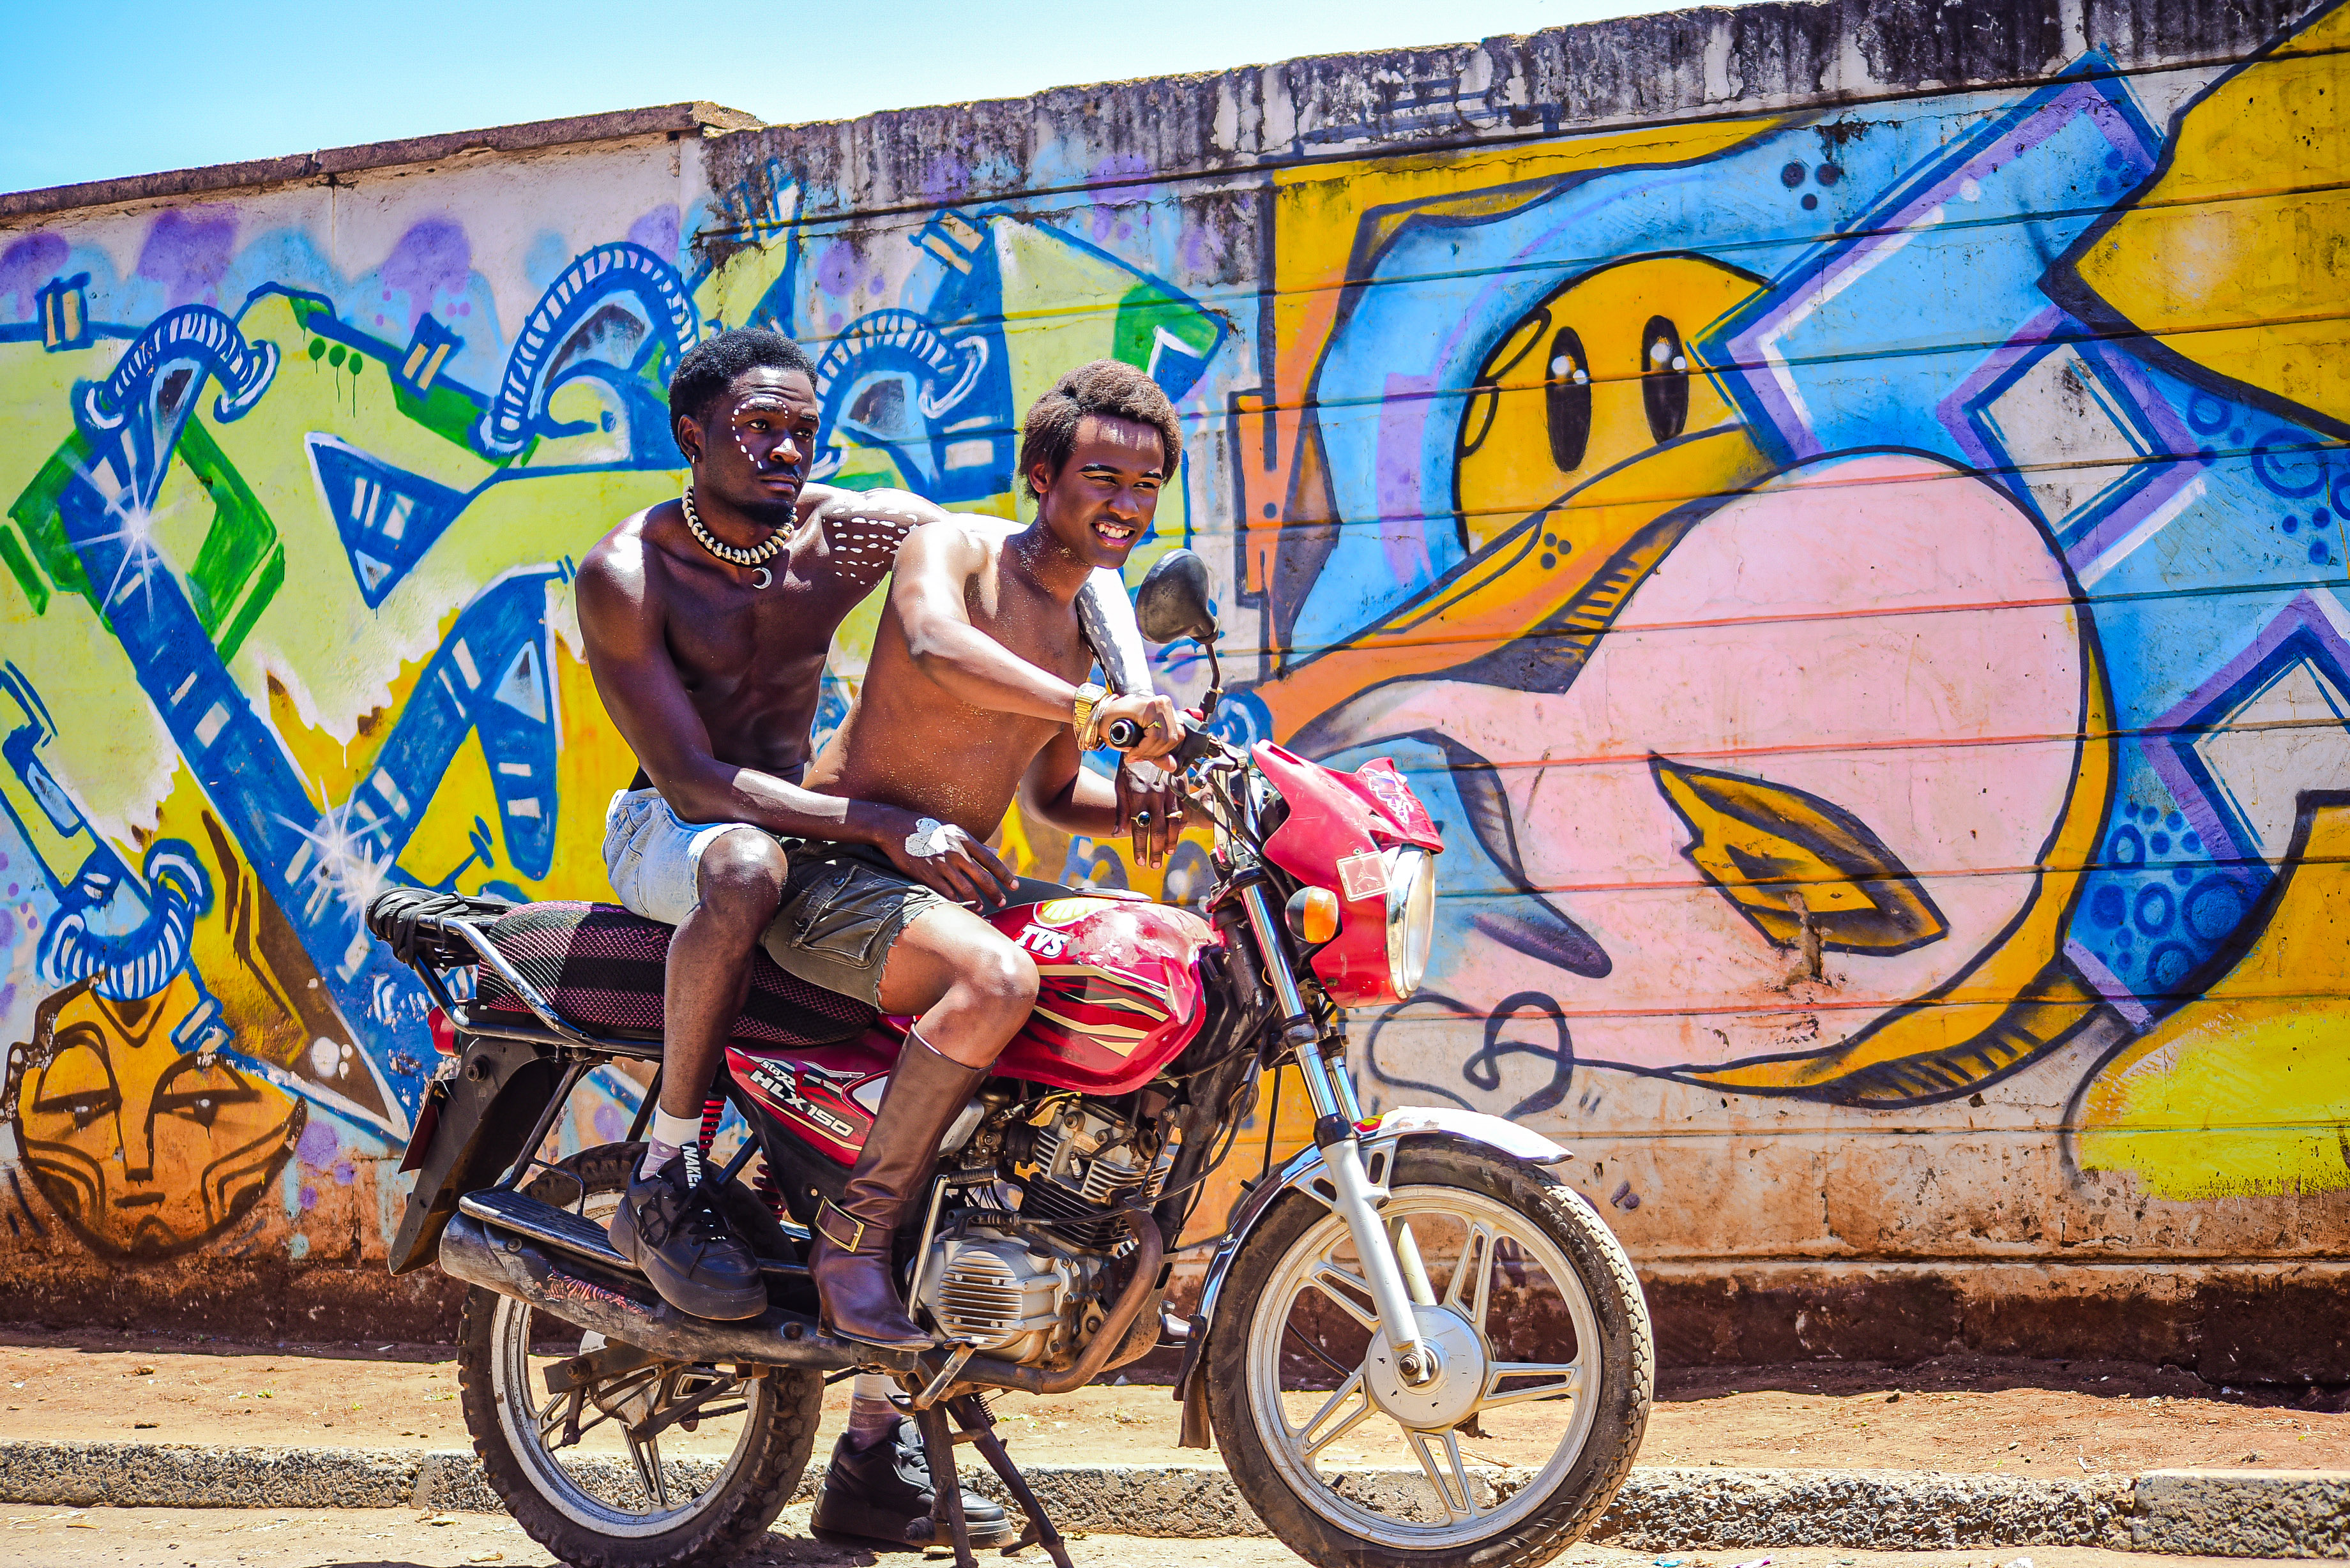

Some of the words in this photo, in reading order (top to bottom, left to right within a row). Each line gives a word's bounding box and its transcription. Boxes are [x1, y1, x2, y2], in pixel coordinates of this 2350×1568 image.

[1015, 923, 1072, 956] TVS
[750, 1069, 808, 1112] HLX
[807, 1104, 854, 1137] 150
